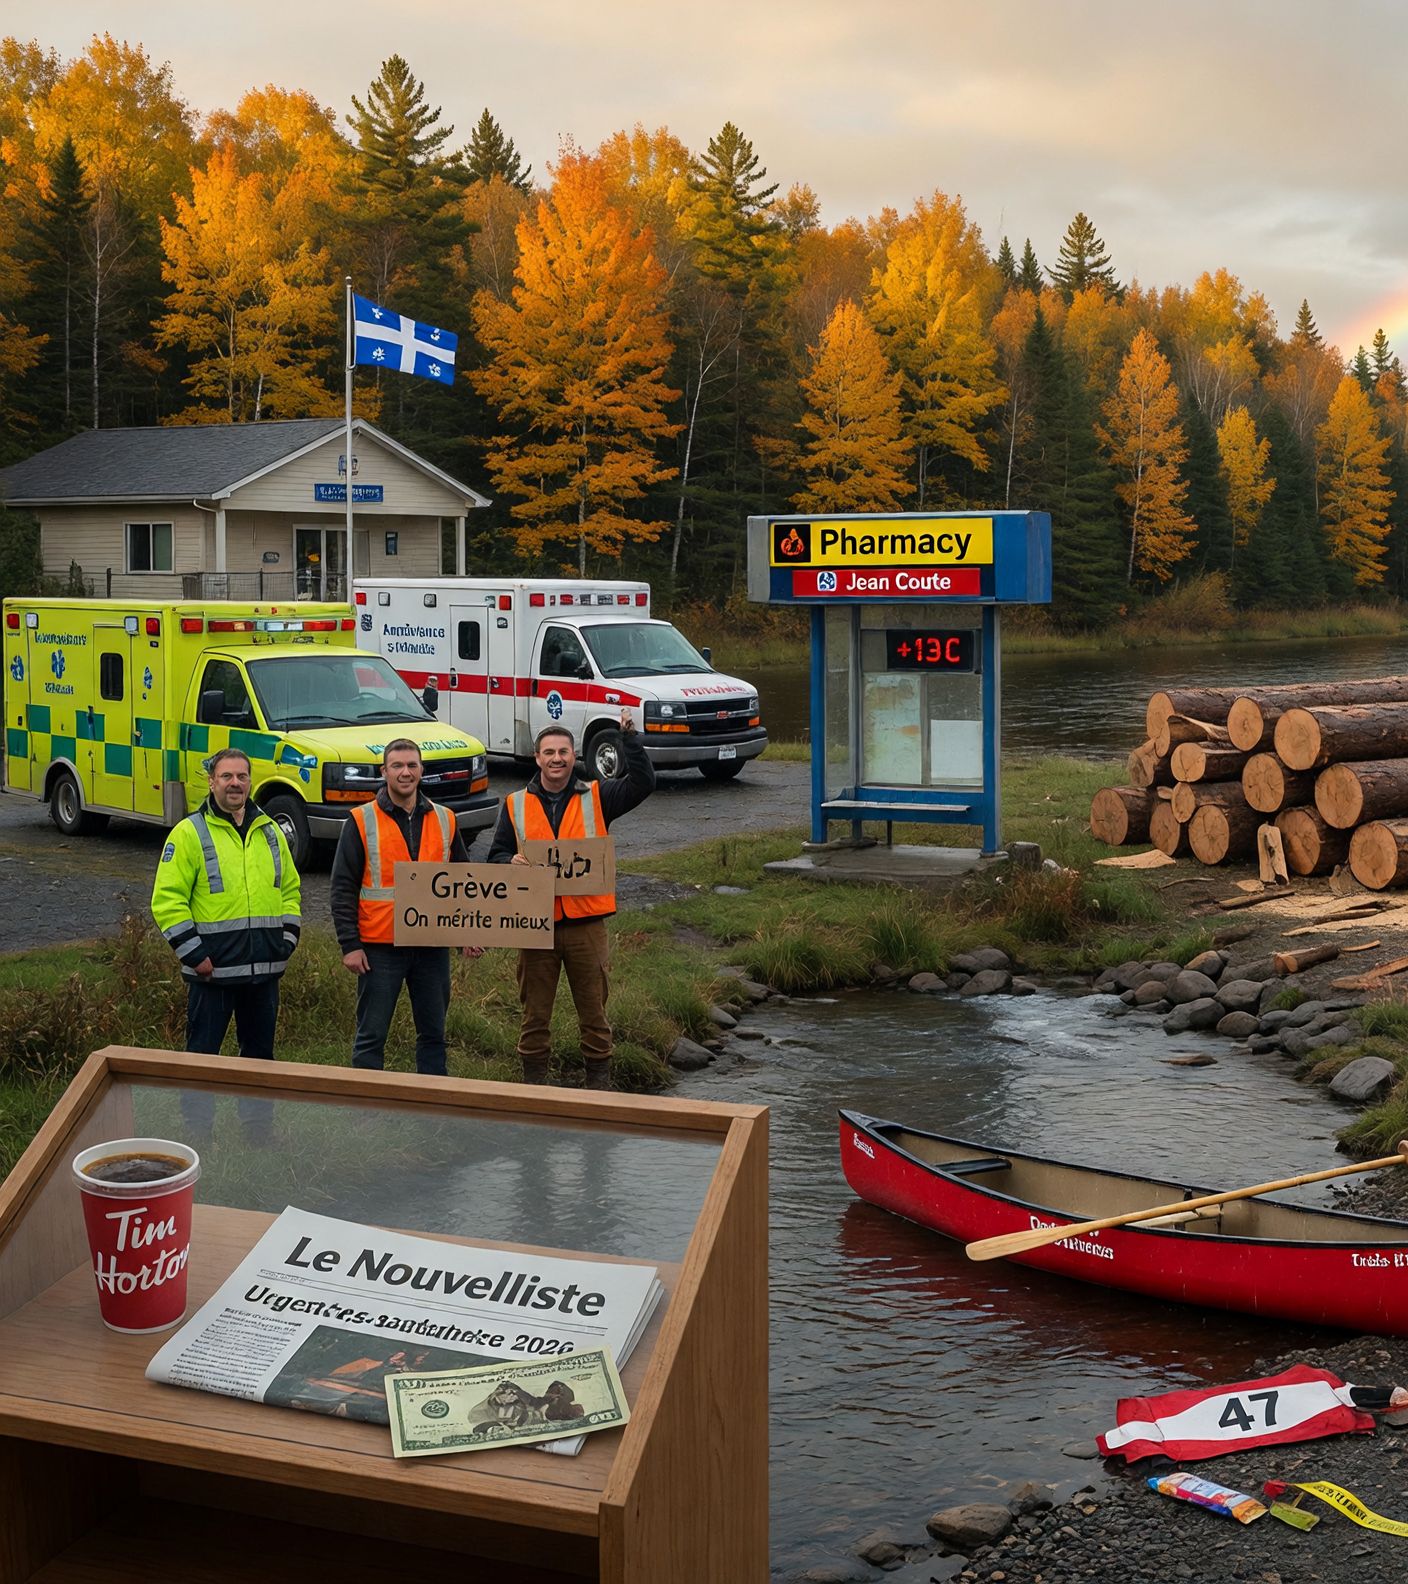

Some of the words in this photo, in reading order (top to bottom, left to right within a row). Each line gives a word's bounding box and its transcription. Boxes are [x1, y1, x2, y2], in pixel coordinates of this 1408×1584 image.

[820, 528, 972, 560] Pharmacy
[846, 573, 890, 591] Jean
[895, 572, 951, 590] Coute
[431, 871, 508, 899] Grève
[404, 907, 428, 928] On
[437, 908, 492, 929] mérite
[500, 912, 550, 931] mieux
[105, 1207, 177, 1252] Tim
[284, 1236, 341, 1273] Le
[346, 1248, 606, 1317] Nouvelliste
[1218, 1390, 1279, 1432] 47
